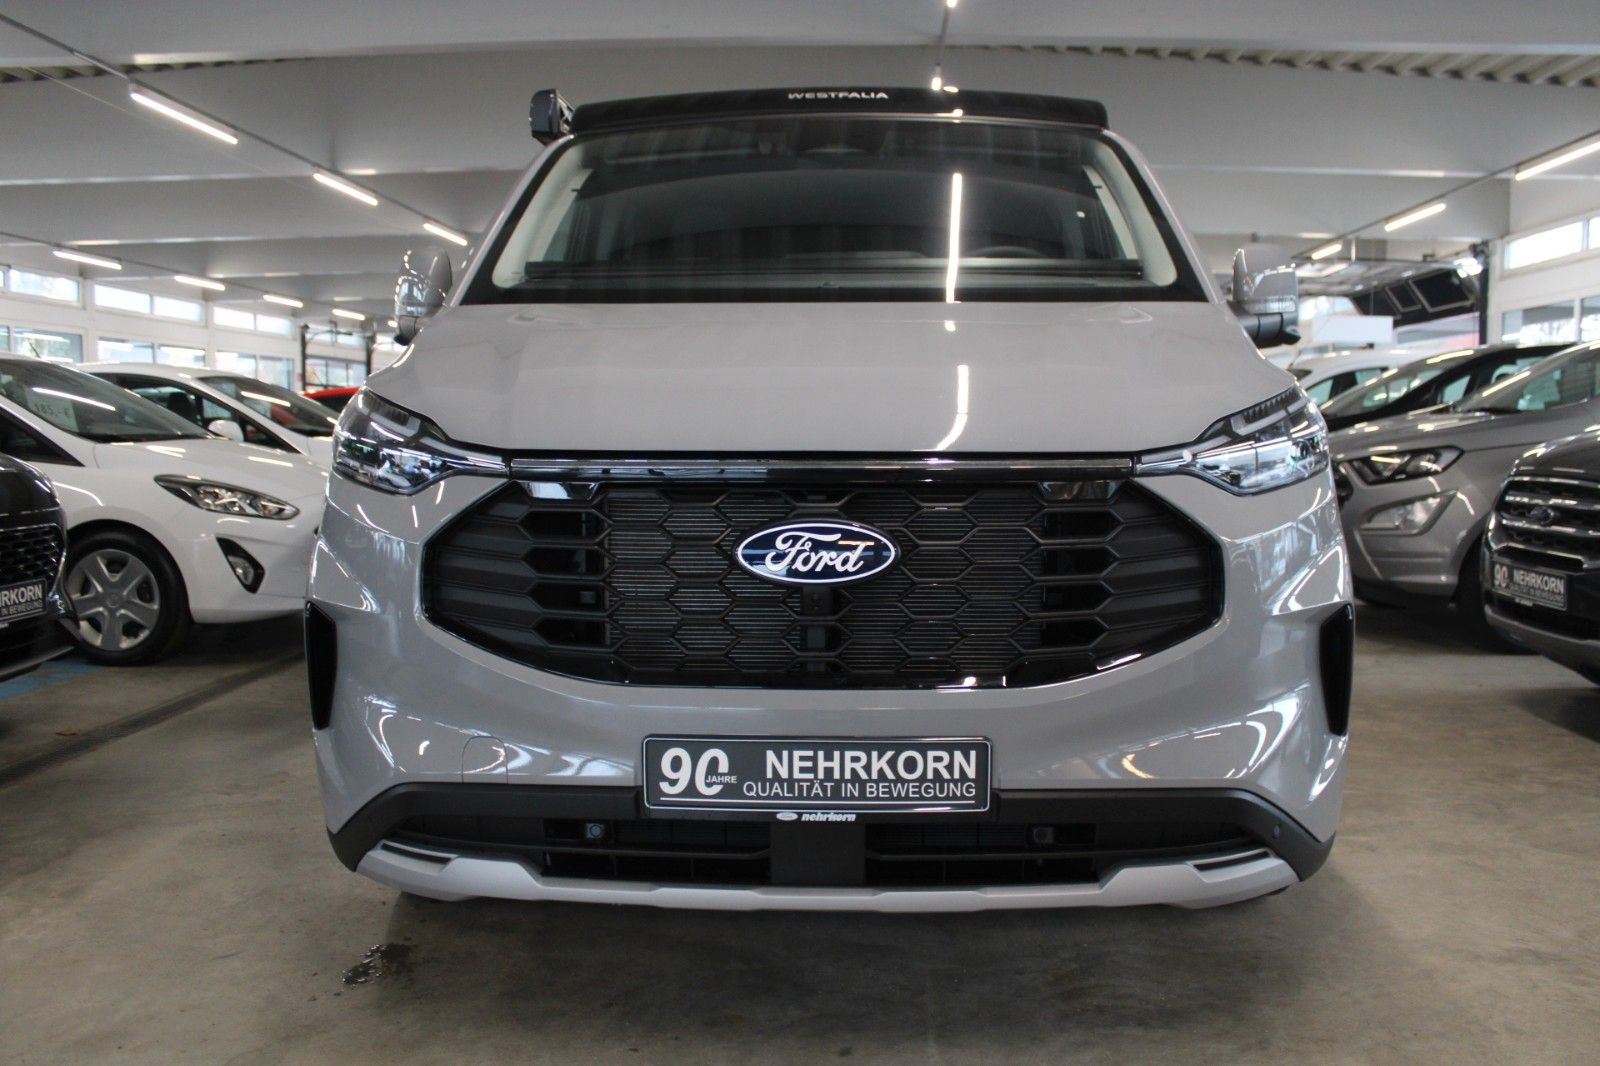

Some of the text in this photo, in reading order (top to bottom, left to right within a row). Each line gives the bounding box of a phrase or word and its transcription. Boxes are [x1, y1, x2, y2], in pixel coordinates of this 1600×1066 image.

[788, 91, 888, 99] WESTFALIA
[765, 531, 864, 572] Ford
[1513, 567, 1564, 594] NEHRKORN
[0, 584, 42, 607] RKORN
[659, 748, 729, 796] 90
[766, 750, 976, 780] NEHRKORN
[706, 775, 737, 784] JAHRE
[743, 780, 976, 798] QUALITÄT IN BEWEGUNG
[801, 812, 857, 822] nehrkorn
